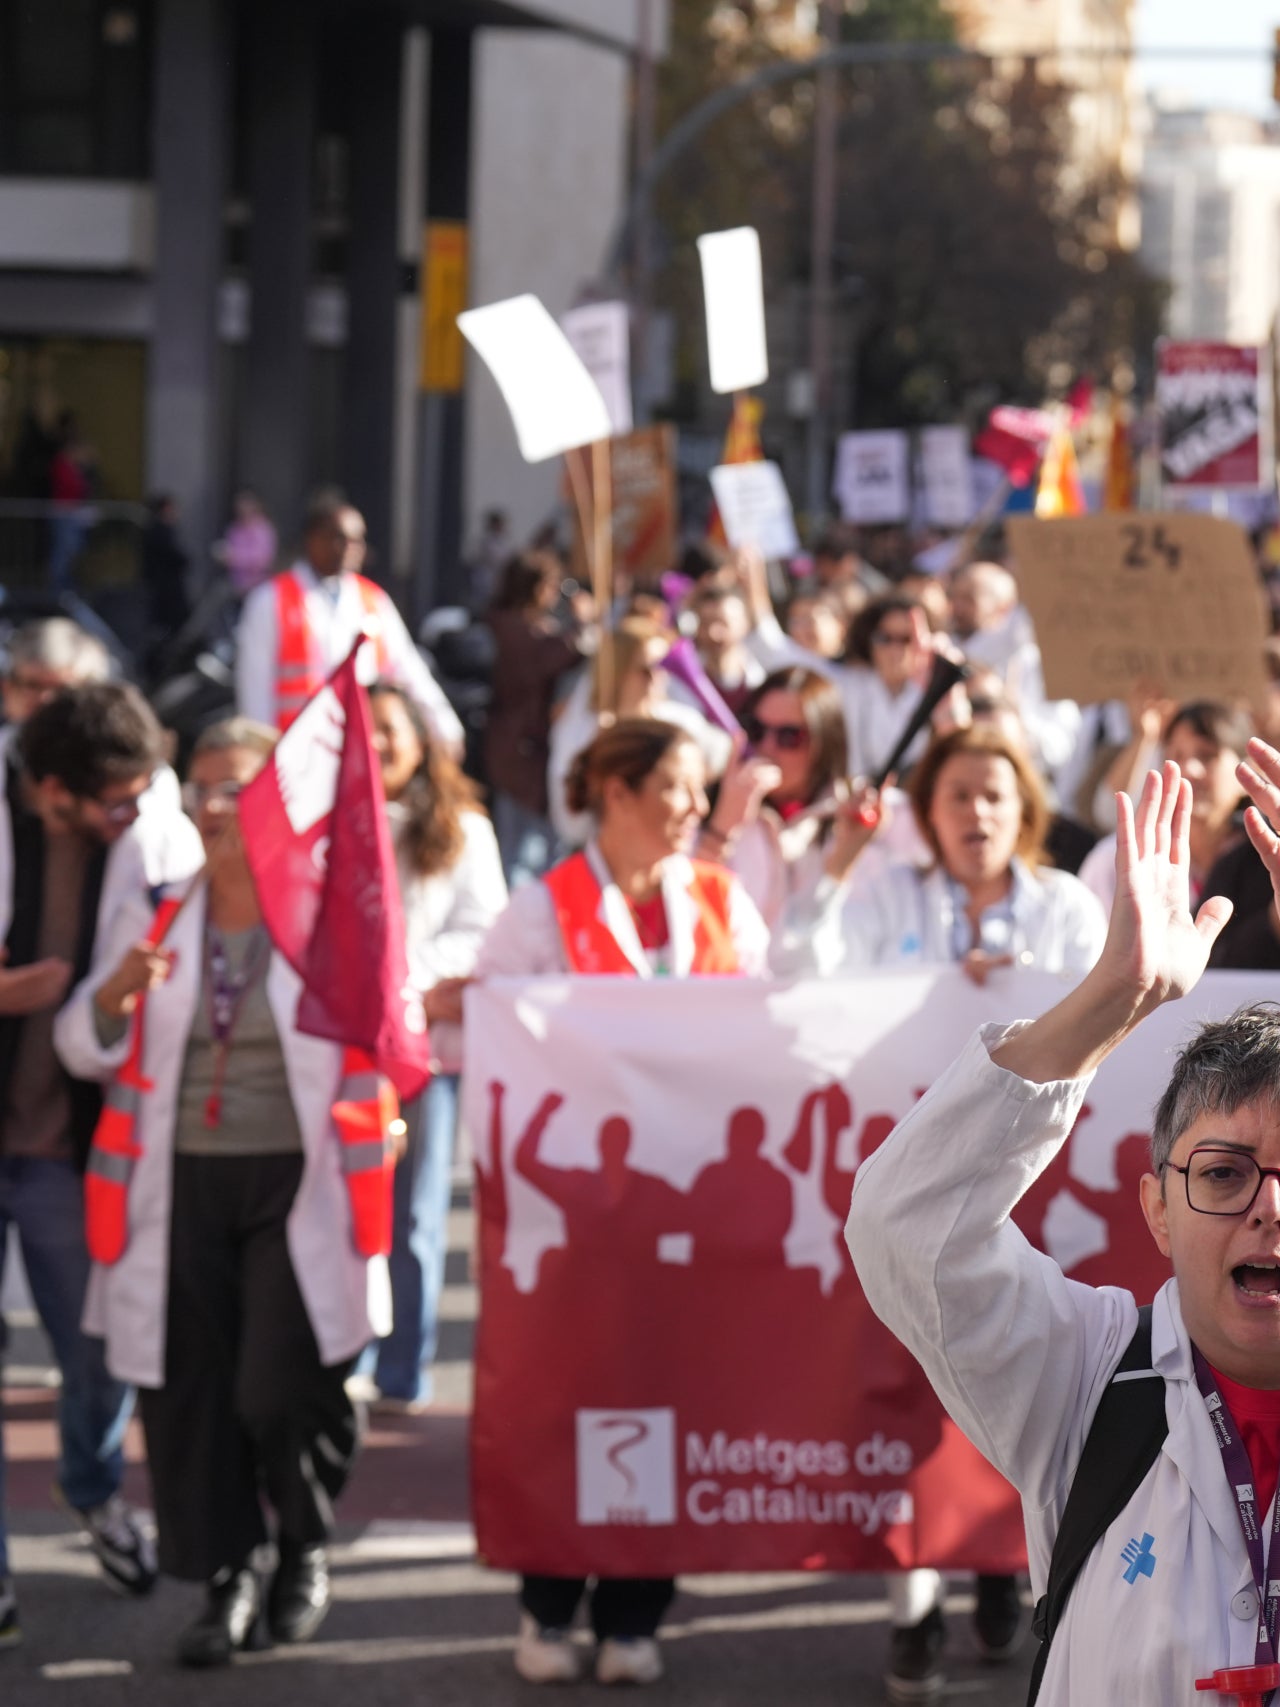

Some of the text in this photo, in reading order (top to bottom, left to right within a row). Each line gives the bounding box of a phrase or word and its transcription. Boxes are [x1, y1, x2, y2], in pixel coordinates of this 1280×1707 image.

[685, 1431, 913, 1484] Metges de
[685, 1479, 914, 1526] Catalunya
